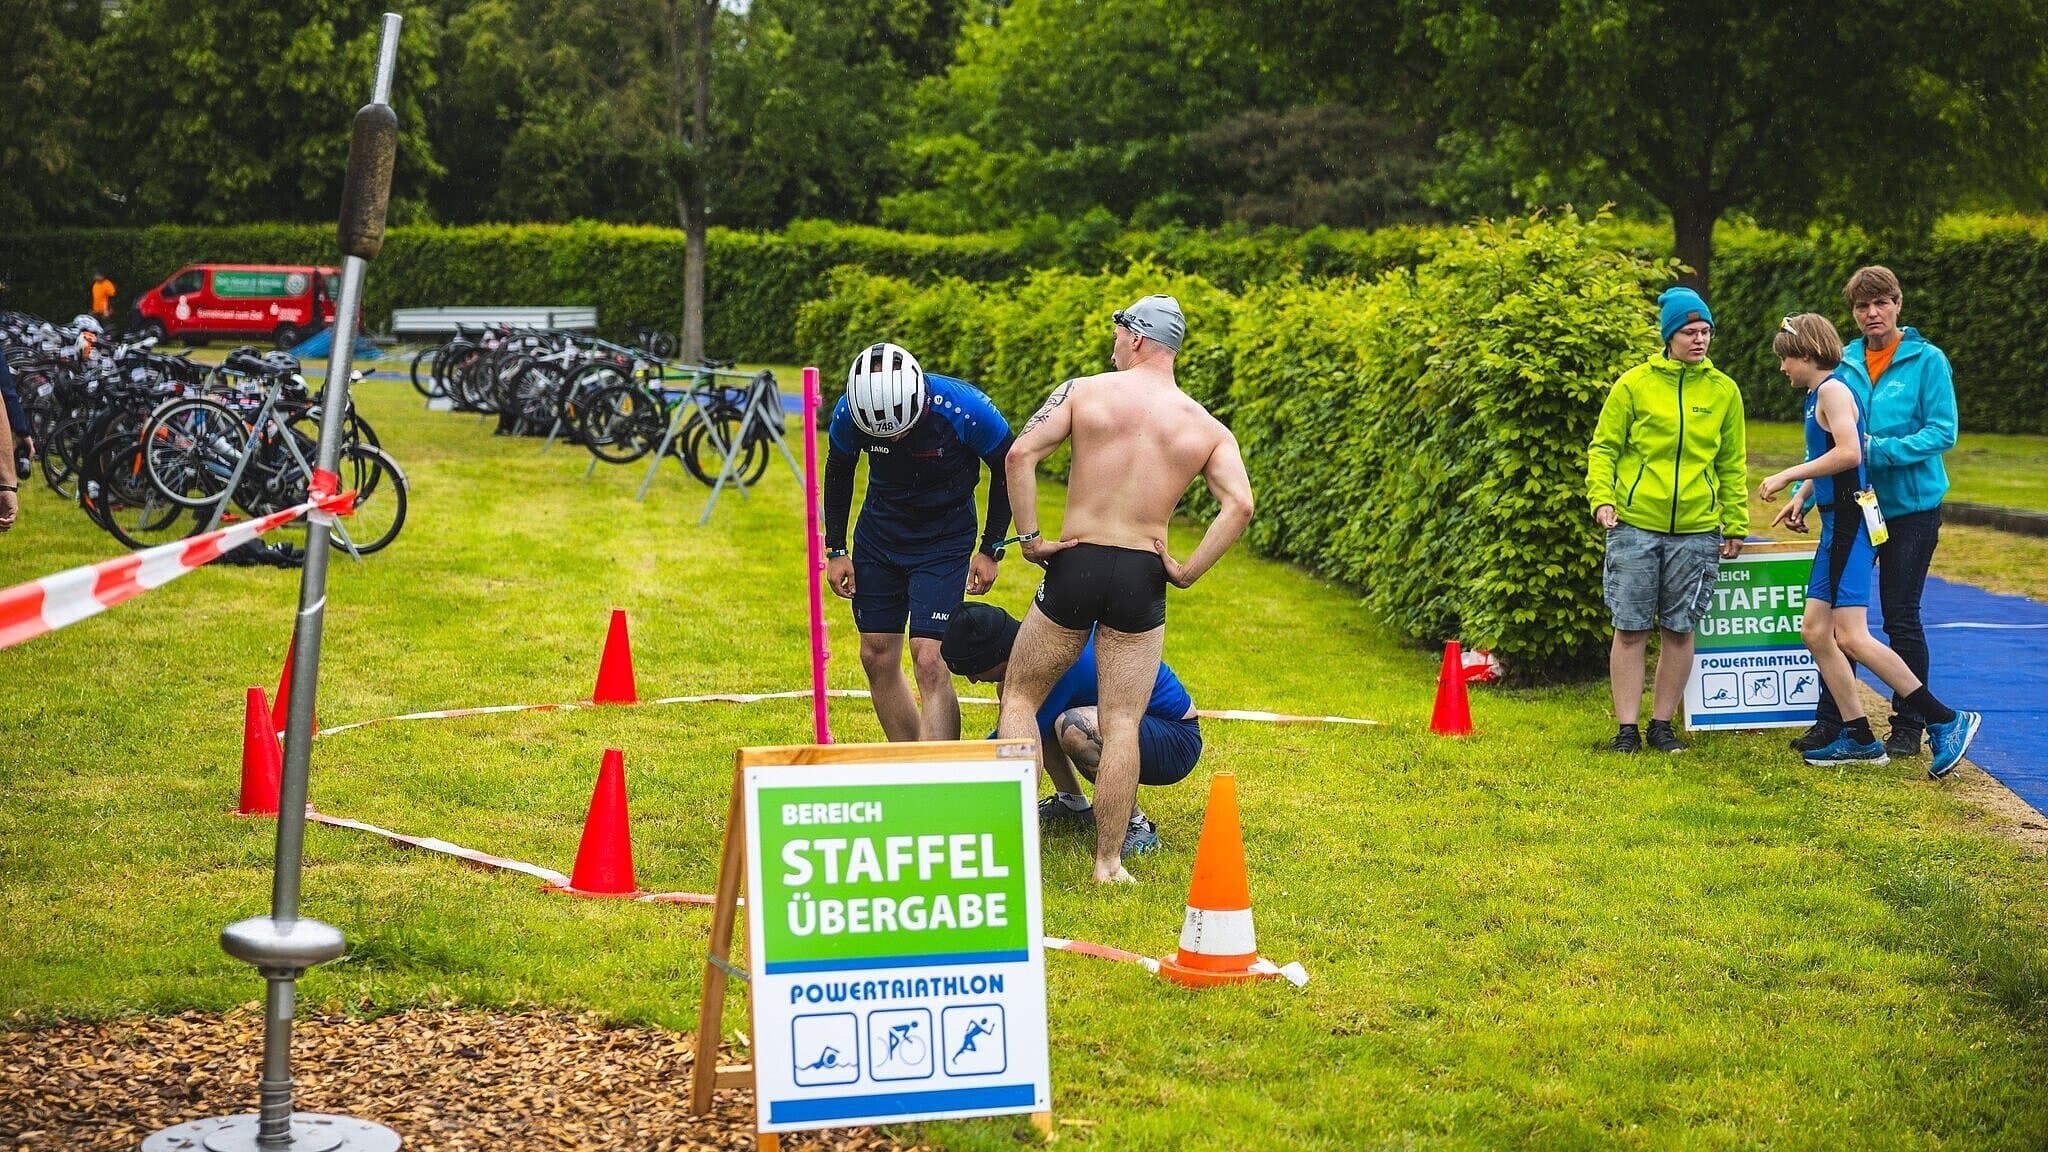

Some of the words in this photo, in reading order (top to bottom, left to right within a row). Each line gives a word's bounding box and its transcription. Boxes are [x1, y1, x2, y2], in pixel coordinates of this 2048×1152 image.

[875, 421, 894, 432] 748
[870, 445, 890, 454] JAKO
[1705, 585, 1809, 611] TAFFE
[1700, 614, 1804, 636] ÜBERGAB
[782, 801, 883, 825] BEREICH
[781, 833, 1009, 886] STAFFEL
[787, 891, 1008, 936] ÜBERGABE
[790, 974, 1004, 1004] POWERTRIATHLON
